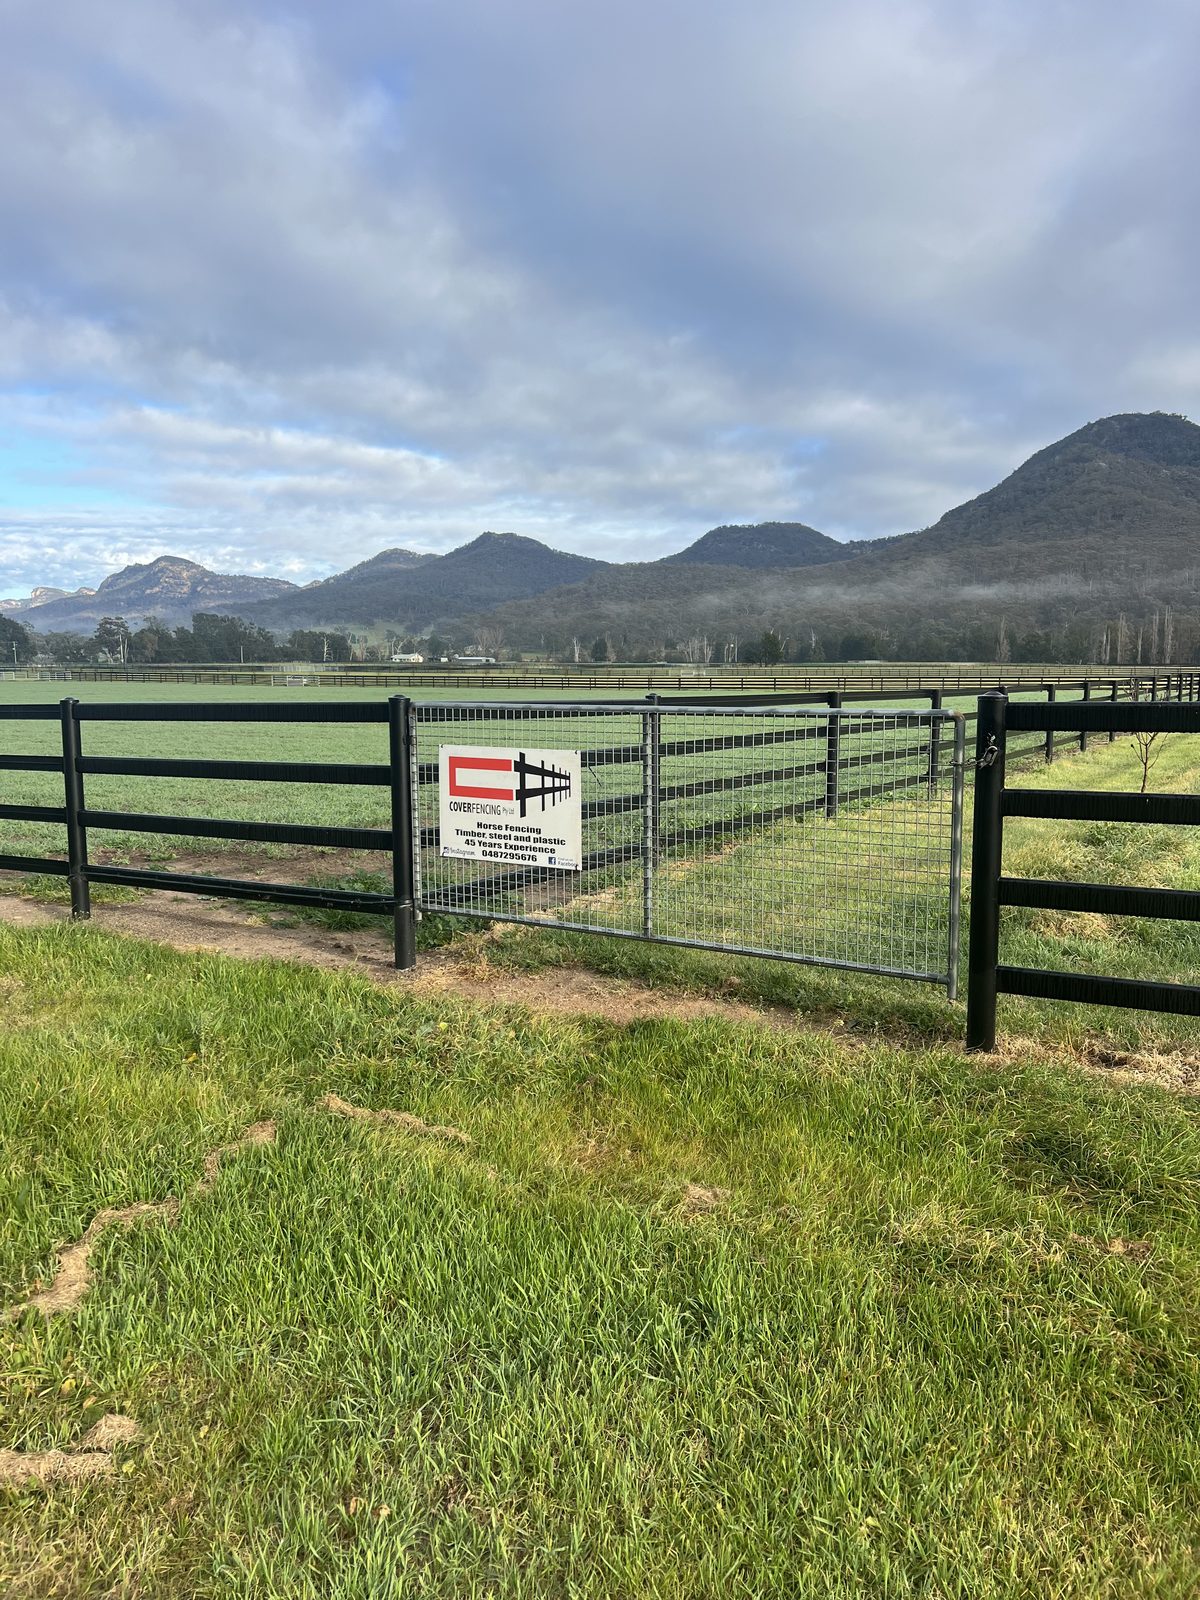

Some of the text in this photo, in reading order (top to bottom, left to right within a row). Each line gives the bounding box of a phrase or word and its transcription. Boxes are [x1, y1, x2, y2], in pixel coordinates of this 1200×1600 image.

[449, 801, 501, 816] COVERFENCING
[476, 822, 541, 835] Horse Fencing
[455, 828, 566, 846] Timber, steel and plastic
[464, 838, 556, 855] 45 Years Experience
[482, 850, 537, 862] 0487295676
